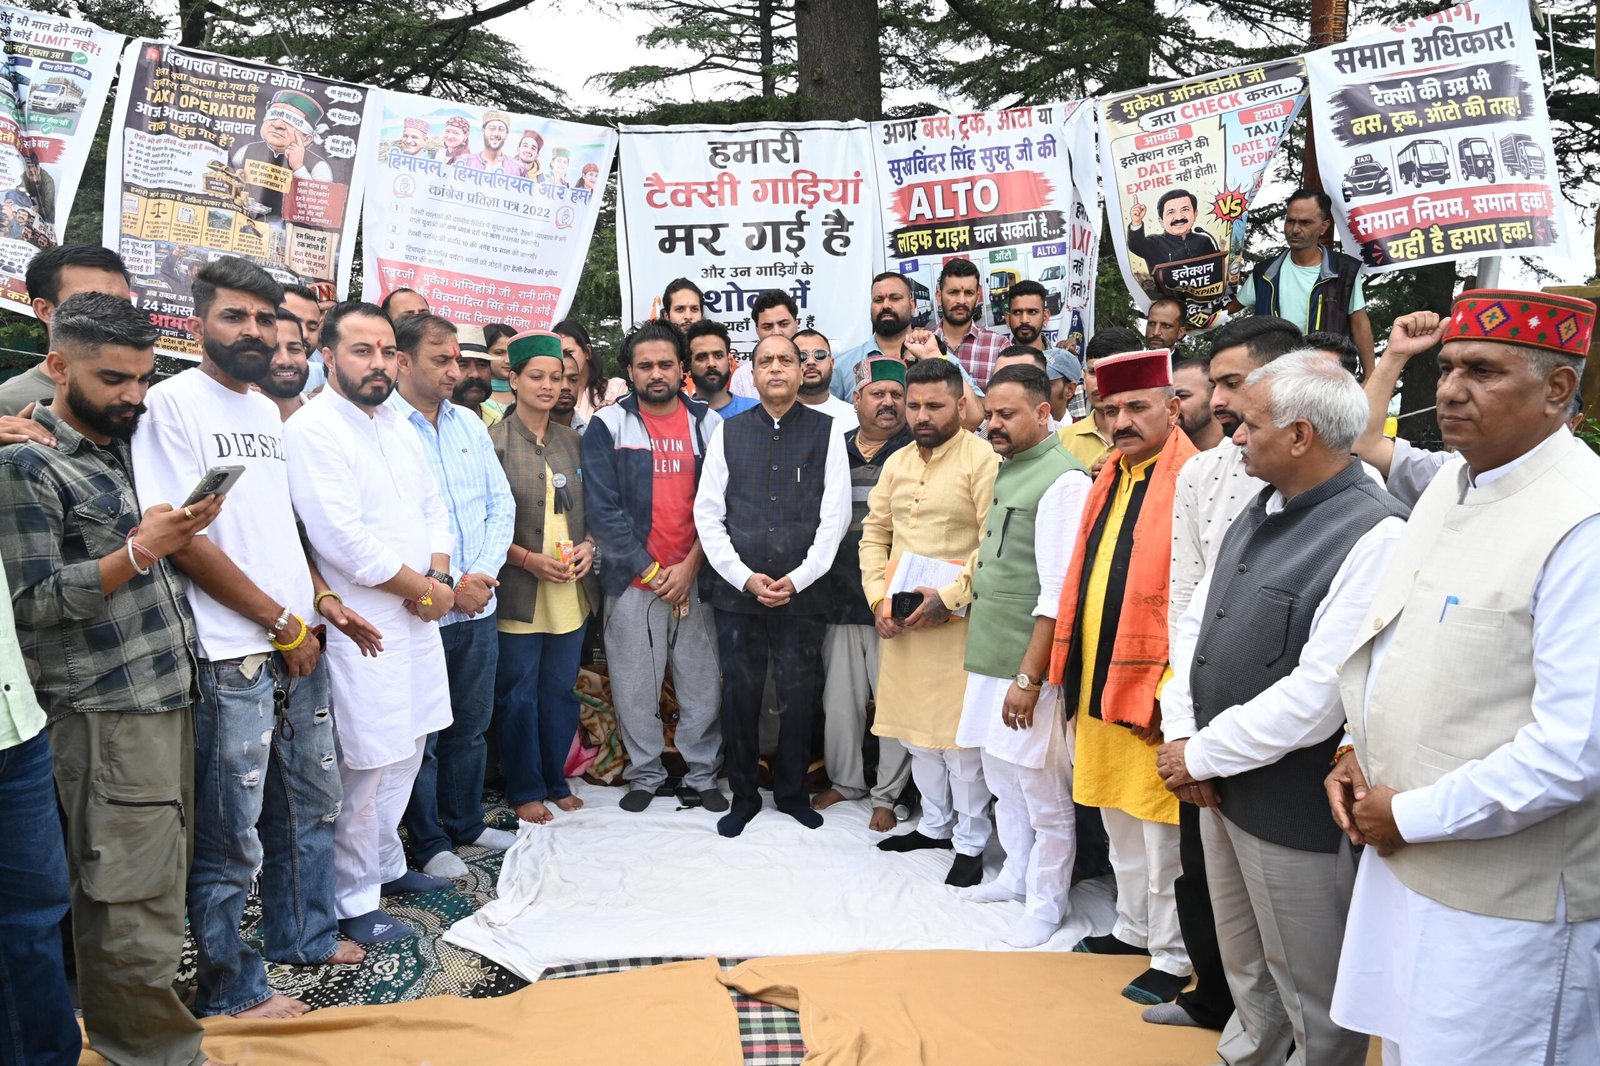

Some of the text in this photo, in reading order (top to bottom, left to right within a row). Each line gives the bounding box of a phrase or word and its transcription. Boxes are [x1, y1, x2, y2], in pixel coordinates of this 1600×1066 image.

[17, 16, 93, 38] भी माल ढोने वाली
[14, 30, 101, 56] कोई LIMIT नहीं!
[28, 48, 48, 57] पूछता
[1332, 21, 1516, 75] समान अधिकार!
[162, 46, 217, 76] हिमाचल
[219, 62, 269, 84] सरकार
[171, 71, 187, 80] क्या
[190, 77, 216, 88] कारण
[218, 80, 228, 90] हो
[230, 83, 246, 92] गया
[248, 83, 260, 93] कि
[180, 83, 212, 98] खजाना
[238, 93, 256, 104] वाले
[1369, 68, 1492, 107] टैक्सी की उम्र भी
[145, 87, 256, 120] TAXI OPERATOR
[1121, 93, 1165, 119] मुकेश
[1149, 110, 1176, 128] जरा
[1180, 92, 1243, 120] CHECK
[1253, 104, 1284, 122] हमारी
[1350, 95, 1522, 136] बस, ट्रक, ऑटो की तरह!
[135, 102, 256, 136] आज आमरण अनशन
[883, 120, 918, 145] अगर
[921, 117, 955, 140] बस,
[958, 112, 993, 142] ट्रक,
[1037, 107, 1053, 125] या
[1244, 121, 1279, 138] TAXI
[198, 127, 217, 141] गए
[1142, 126, 1180, 147] आपकी
[1232, 139, 1263, 155] DATE
[708, 130, 802, 169] हमारी
[888, 145, 946, 185] सुखविंदर
[950, 144, 976, 171] सिंह
[1015, 137, 1033, 161] जी
[1037, 133, 1057, 159] की
[1120, 136, 1210, 169] इलेक्शन लड़ने की
[1356, 155, 1371, 164] TAXI
[387, 147, 447, 178] हिमाचल,
[453, 159, 534, 196] हिमाचलियत
[1126, 163, 1218, 195] EXPIRE नहीं होती!
[1137, 152, 1203, 179] DATE कभी
[428, 183, 551, 218] कांग्रेस प्रतिज्ञा पत्र 2022
[643, 169, 864, 209] टैक्सी गाड़ियां
[908, 178, 999, 221] ALTO
[1215, 196, 1242, 217] VS
[1355, 191, 1548, 236] समान नियम, समान हक!
[655, 208, 854, 258] मर गई है
[897, 228, 932, 256] लाइफ
[935, 225, 970, 250] टाइम
[973, 222, 997, 244] चल
[1001, 216, 1037, 241] सकती
[1040, 212, 1060, 239] है...
[1387, 221, 1533, 259] यही है हमारा हक!
[995, 250, 1012, 262] ऑटो
[1036, 246, 1057, 257] ALTO
[701, 261, 814, 279] और उन गाड़ियों के
[1171, 262, 1215, 281] इलेक्शन
[423, 271, 449, 287] मुकेश
[452, 277, 497, 296] अग्निहोत्री
[498, 286, 510, 298] जी
[789, 279, 811, 309] में
[143, 299, 195, 316] 24 अगस्त
[432, 288, 484, 308] विक्रमादित्य
[487, 298, 504, 312] सिंह
[507, 300, 519, 314] जी
[521, 302, 534, 314] को
[535, 304, 551, 316] कोई
[438, 306, 452, 319] की
[454, 311, 471, 322] याद
[723, 315, 815, 332] यहाँ हैं
[654, 459, 680, 473] LEIN
